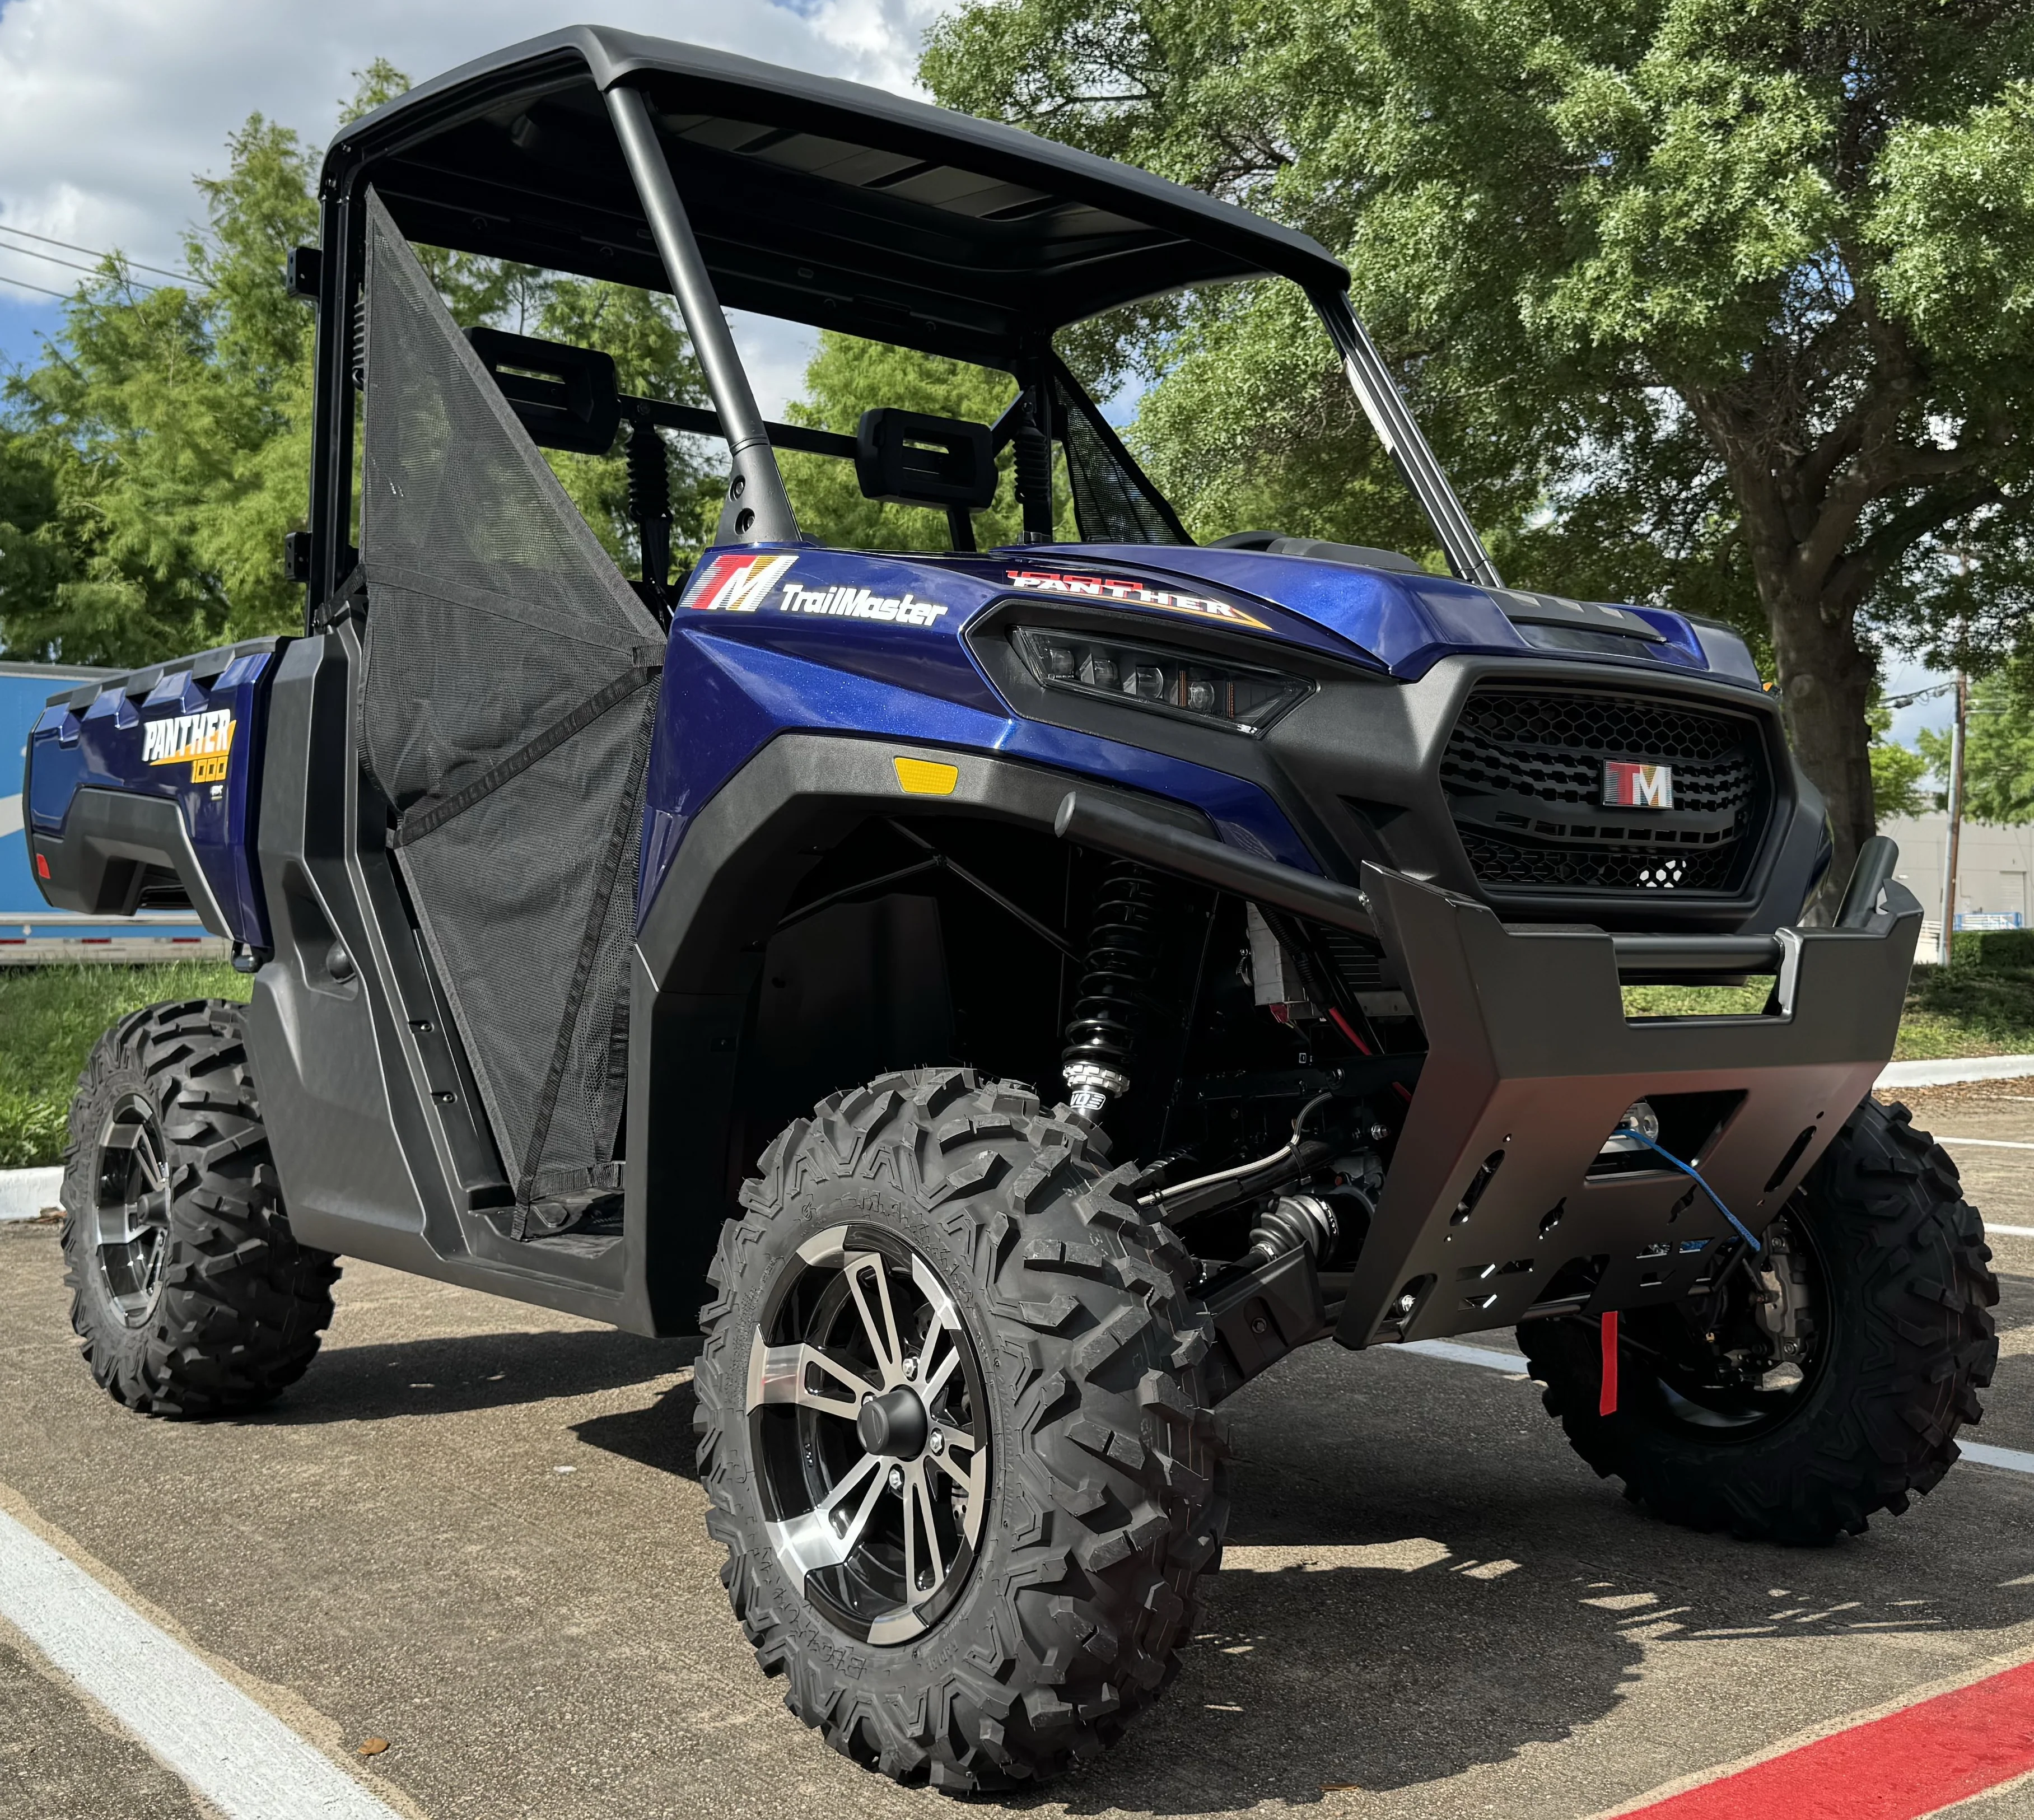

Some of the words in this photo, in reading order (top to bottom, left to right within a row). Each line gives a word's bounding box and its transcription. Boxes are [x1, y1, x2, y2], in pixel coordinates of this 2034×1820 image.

[680, 554, 800, 612] TM
[780, 584, 948, 626] TrailMaster
[1007, 576, 1236, 618] PANTHER
[142, 708, 231, 762] PANTHER
[190, 755, 228, 783] 1000
[1605, 760, 1672, 808] TM
